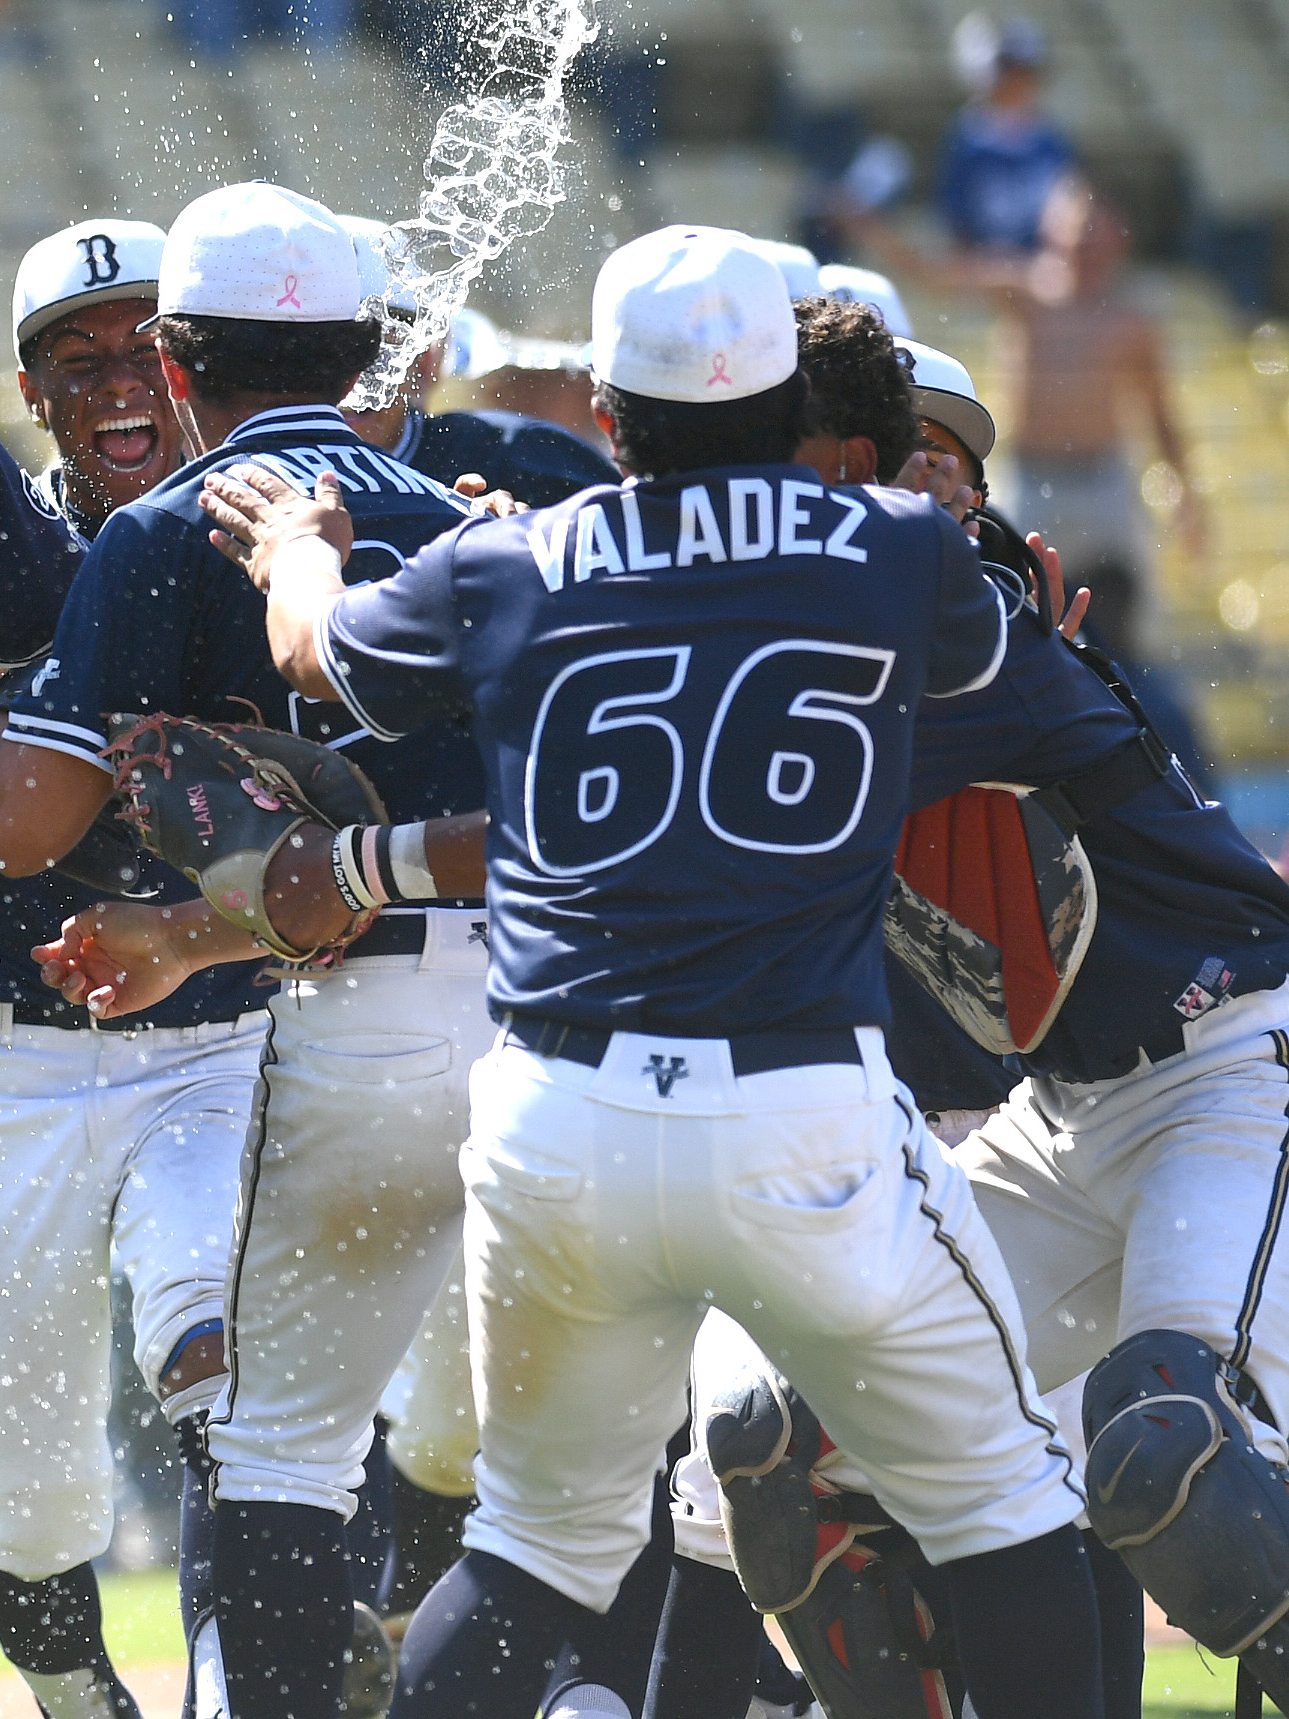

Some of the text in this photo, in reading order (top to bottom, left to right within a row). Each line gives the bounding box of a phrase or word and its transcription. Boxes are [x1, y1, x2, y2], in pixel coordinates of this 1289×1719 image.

[76, 234, 121, 287] B
[235, 444, 476, 517] ARTIN
[526, 478, 868, 593] VALADEZ
[525, 638, 897, 877] 66
